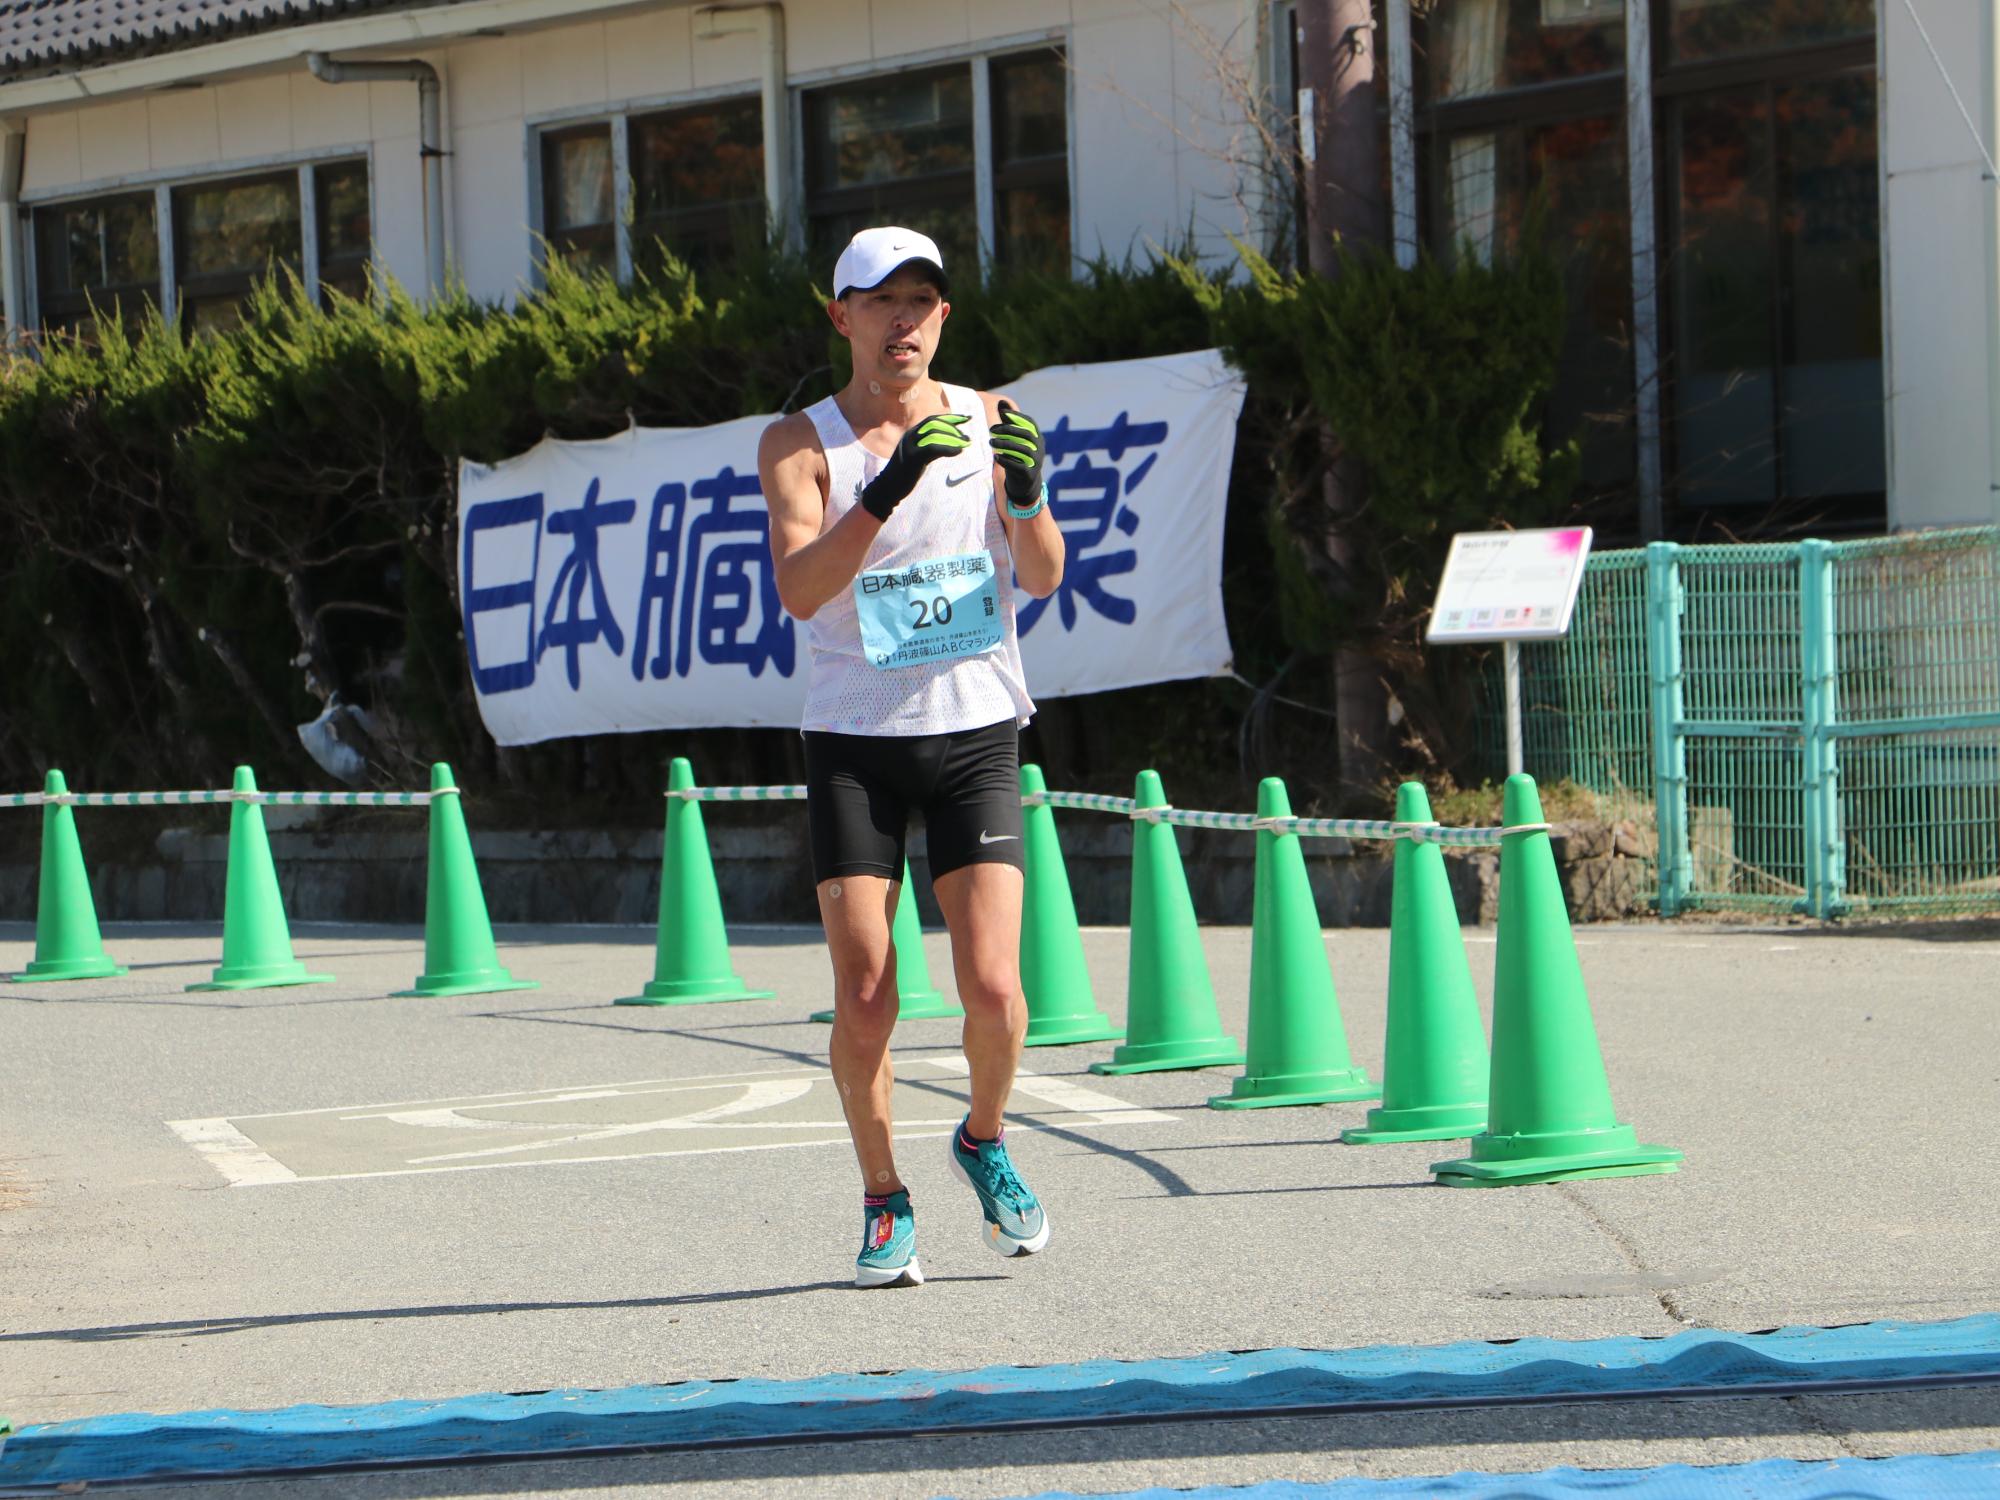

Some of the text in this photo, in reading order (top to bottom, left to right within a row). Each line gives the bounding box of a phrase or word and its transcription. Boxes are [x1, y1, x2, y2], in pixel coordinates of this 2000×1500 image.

[463, 411, 1169, 695] 日本臓薬
[862, 557, 987, 594] 日本臓器製薬
[909, 596, 953, 630] 20
